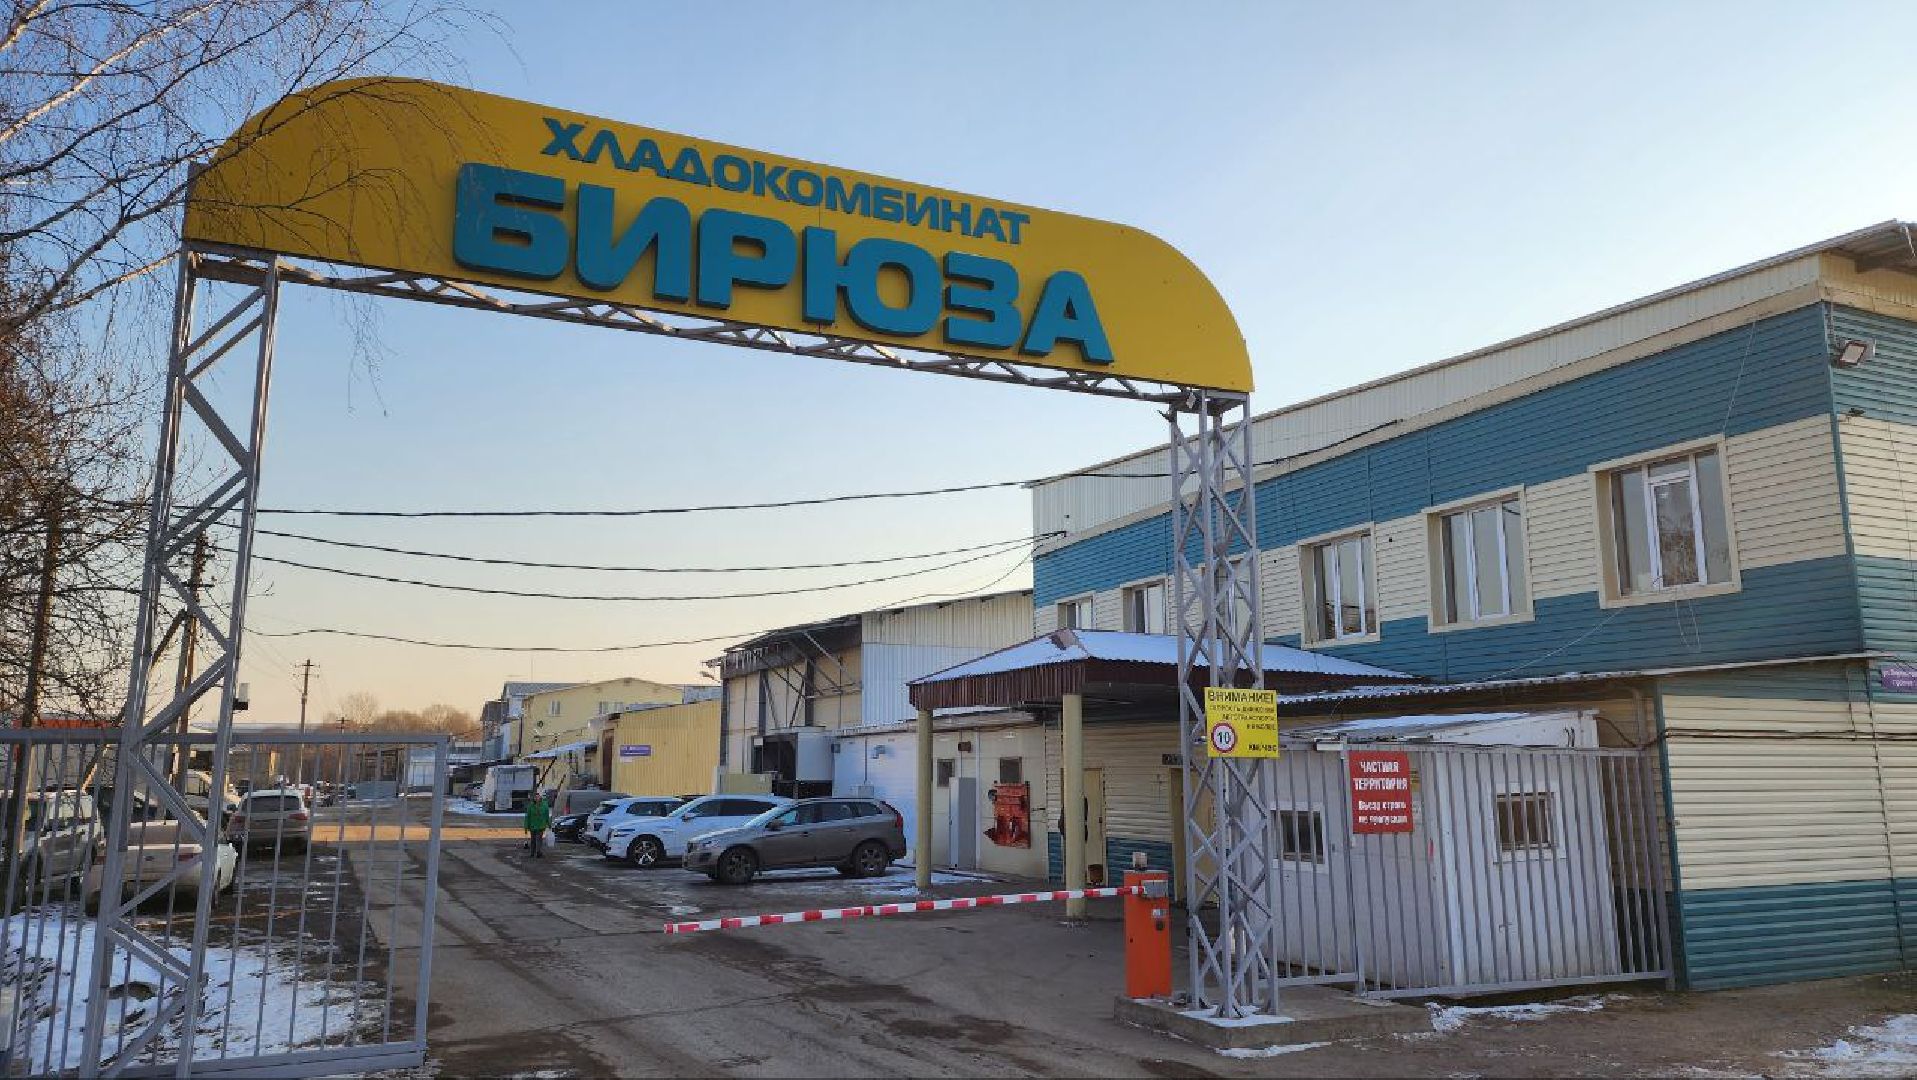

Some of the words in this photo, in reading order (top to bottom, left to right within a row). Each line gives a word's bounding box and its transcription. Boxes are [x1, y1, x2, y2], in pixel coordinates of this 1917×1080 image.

[542, 117, 1030, 245] ХЛАДОКОМБИНАТ
[453, 162, 1113, 365] БИРЮЗА
[1207, 689, 1274, 704] ВНИМАНИЕ!
[1217, 731, 1231, 745] 10
[1360, 761, 1399, 773] ЧАСТНАЯ
[1353, 777, 1408, 790] ТЕРРИТОРИЯ
